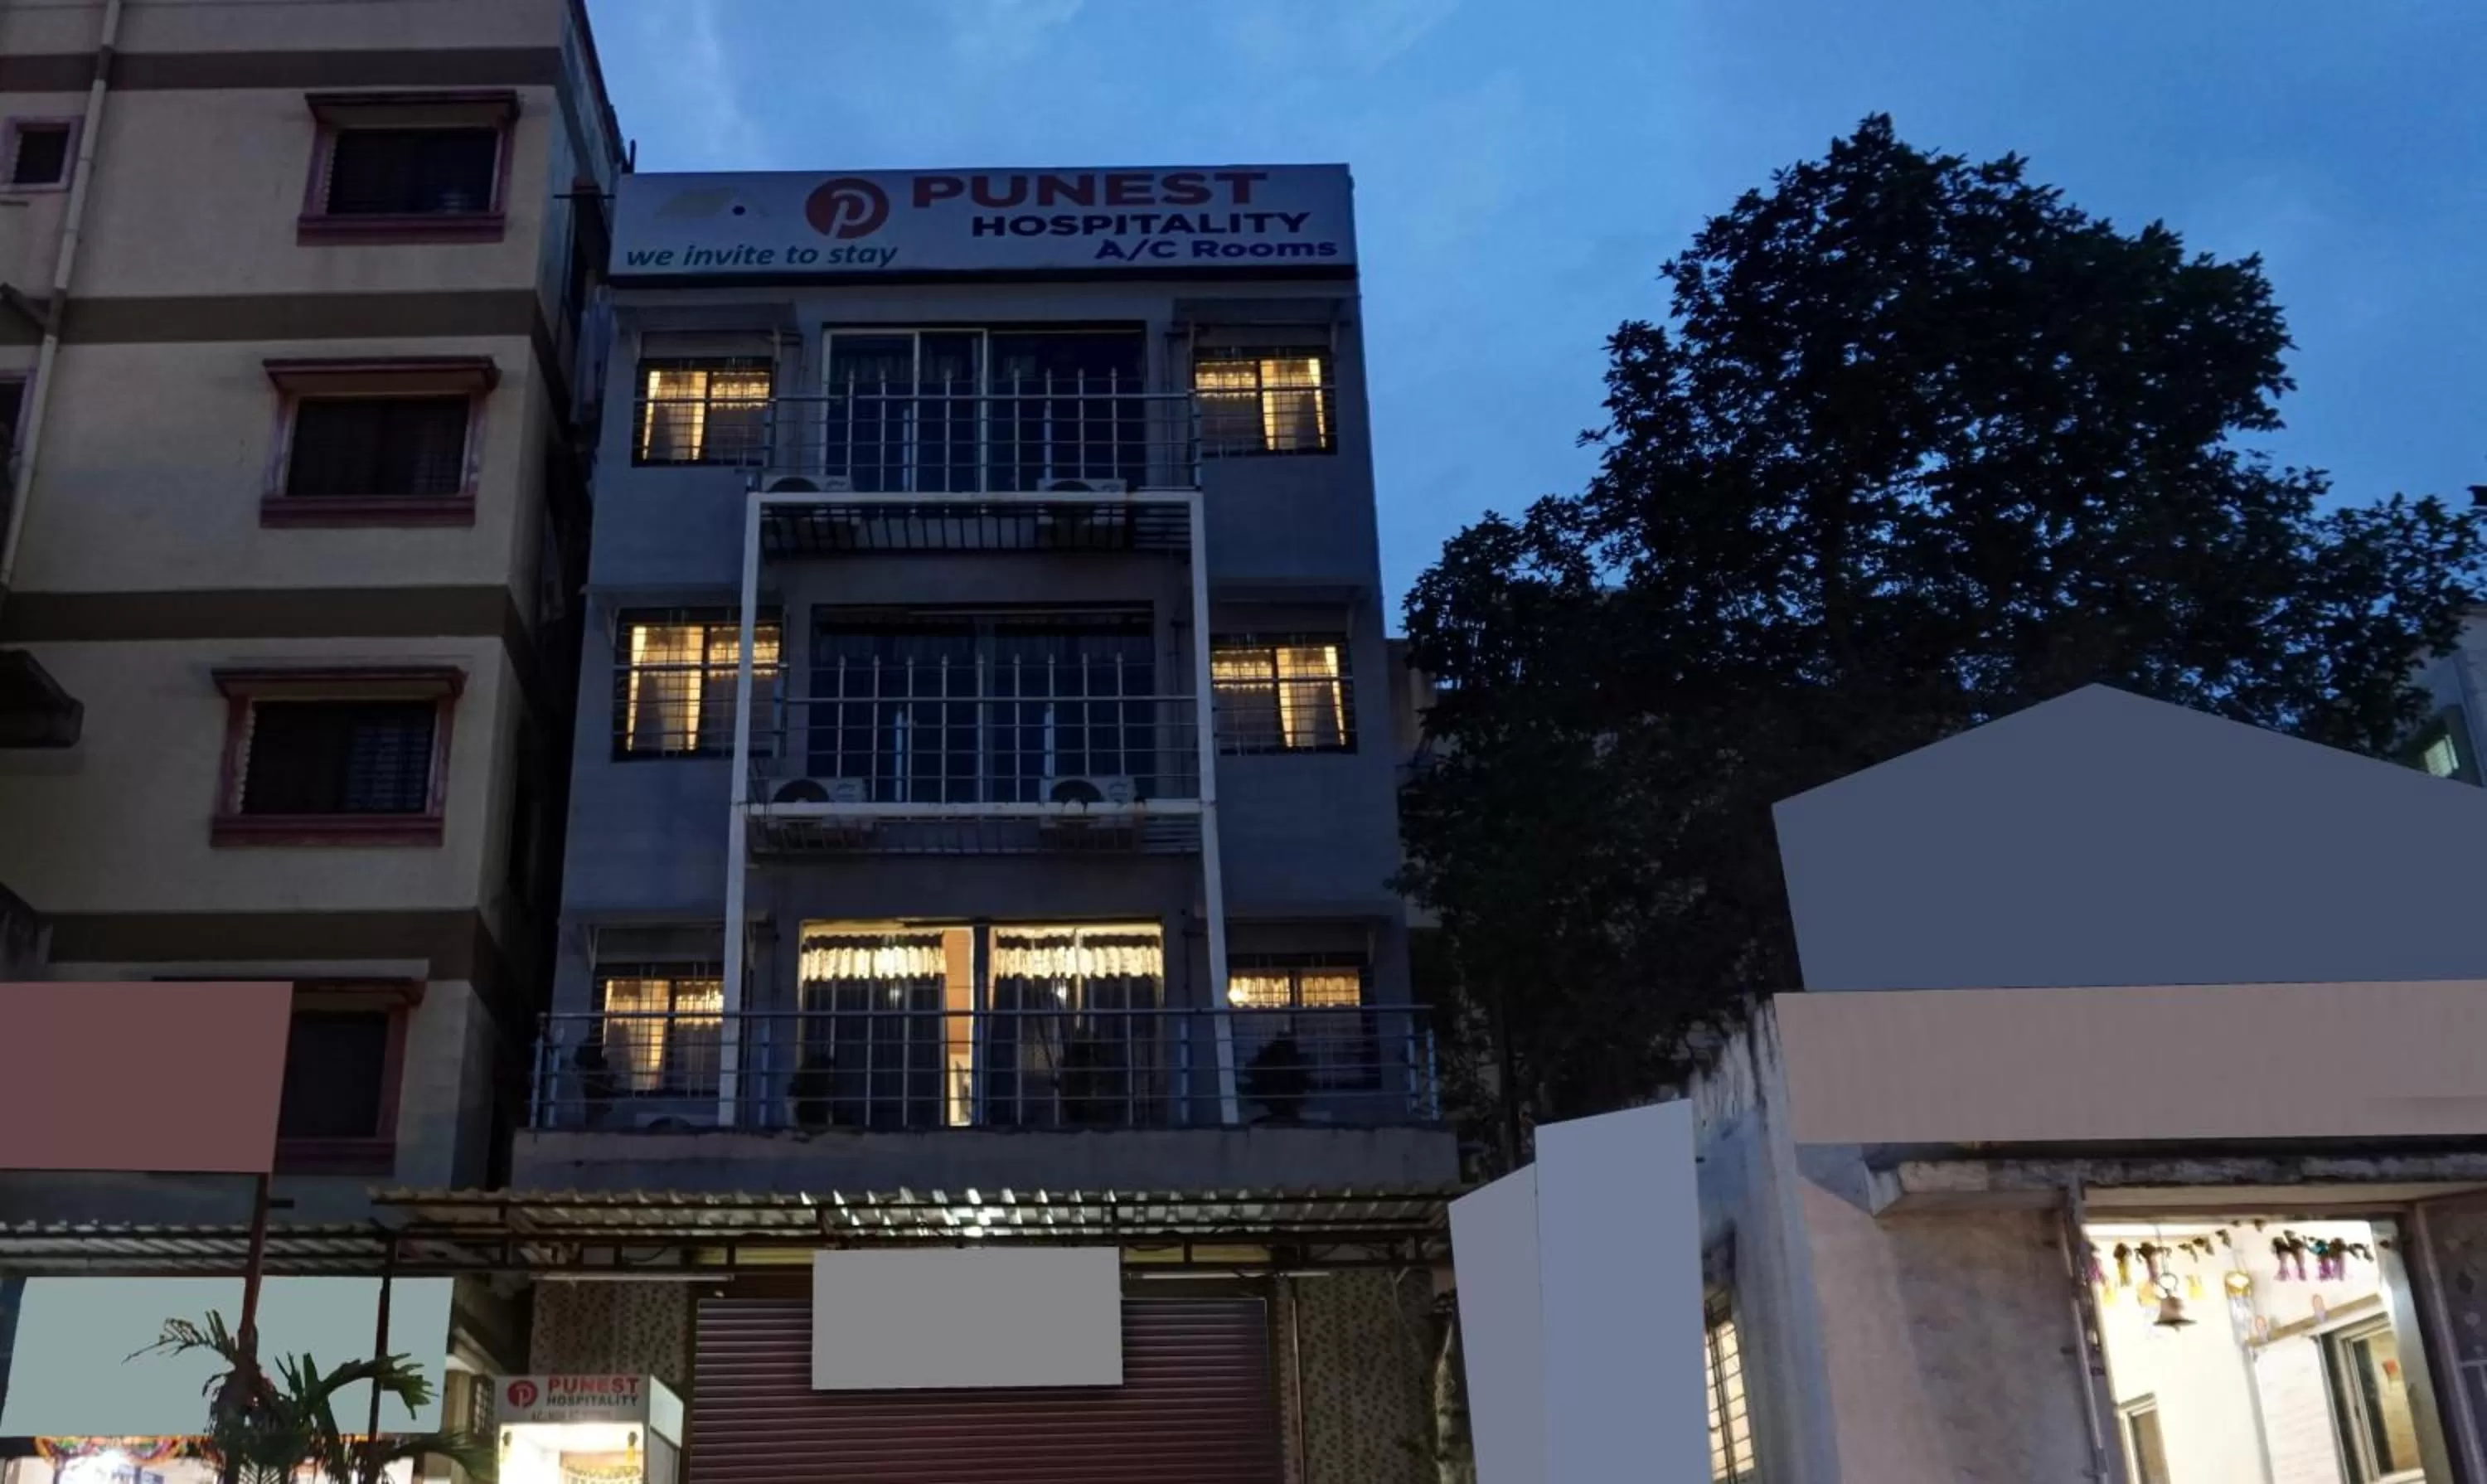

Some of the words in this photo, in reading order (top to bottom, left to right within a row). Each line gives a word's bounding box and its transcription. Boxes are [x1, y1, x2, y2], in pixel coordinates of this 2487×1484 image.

[913, 172, 1268, 208] PUNEST
[972, 212, 1310, 237] HOSPITALITY
[627, 248, 673, 266] we
[683, 244, 775, 265] invite
[786, 245, 819, 265] to
[828, 245, 898, 268] stay
[1094, 239, 1176, 261] A/C
[1191, 240, 1337, 259] Rooms
[548, 1375, 640, 1394] PUNEST
[546, 1394, 639, 1407] HOSPITALITY
